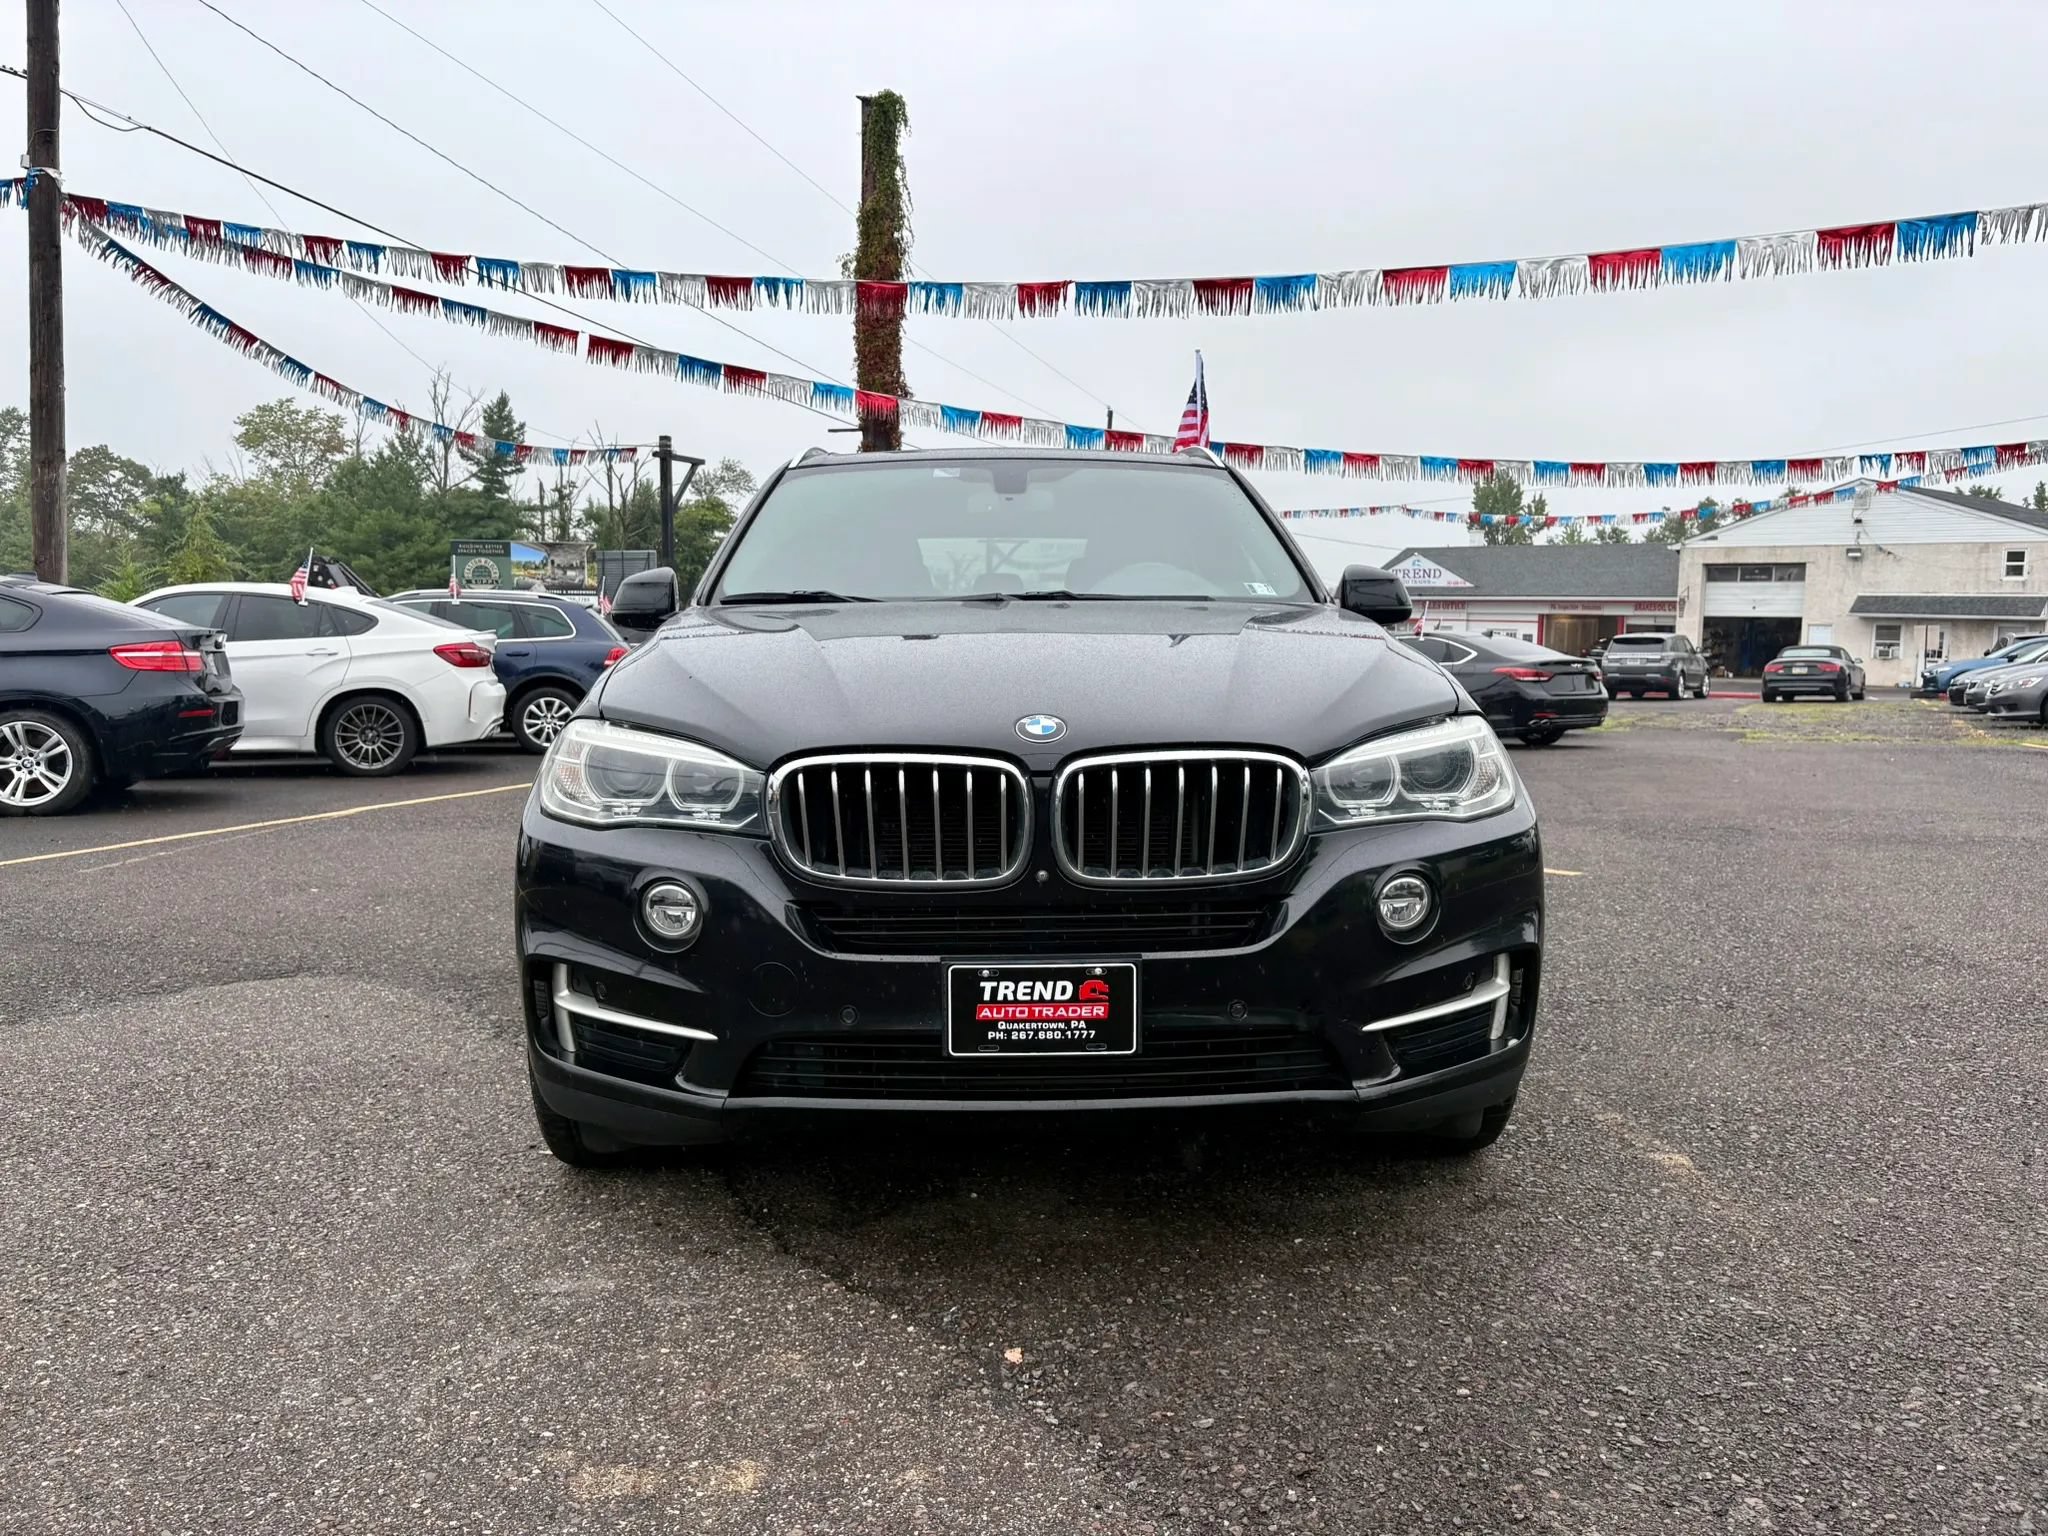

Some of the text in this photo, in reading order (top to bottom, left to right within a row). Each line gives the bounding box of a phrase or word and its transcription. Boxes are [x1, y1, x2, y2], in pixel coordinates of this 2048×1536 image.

[1392, 568, 1442, 579] TREND
[979, 980, 1074, 1001] TREND
[979, 1006, 1105, 1018] AUTO TRADER
[1070, 1020, 1087, 1029] PA
[987, 1031, 1008, 1040] PH:
